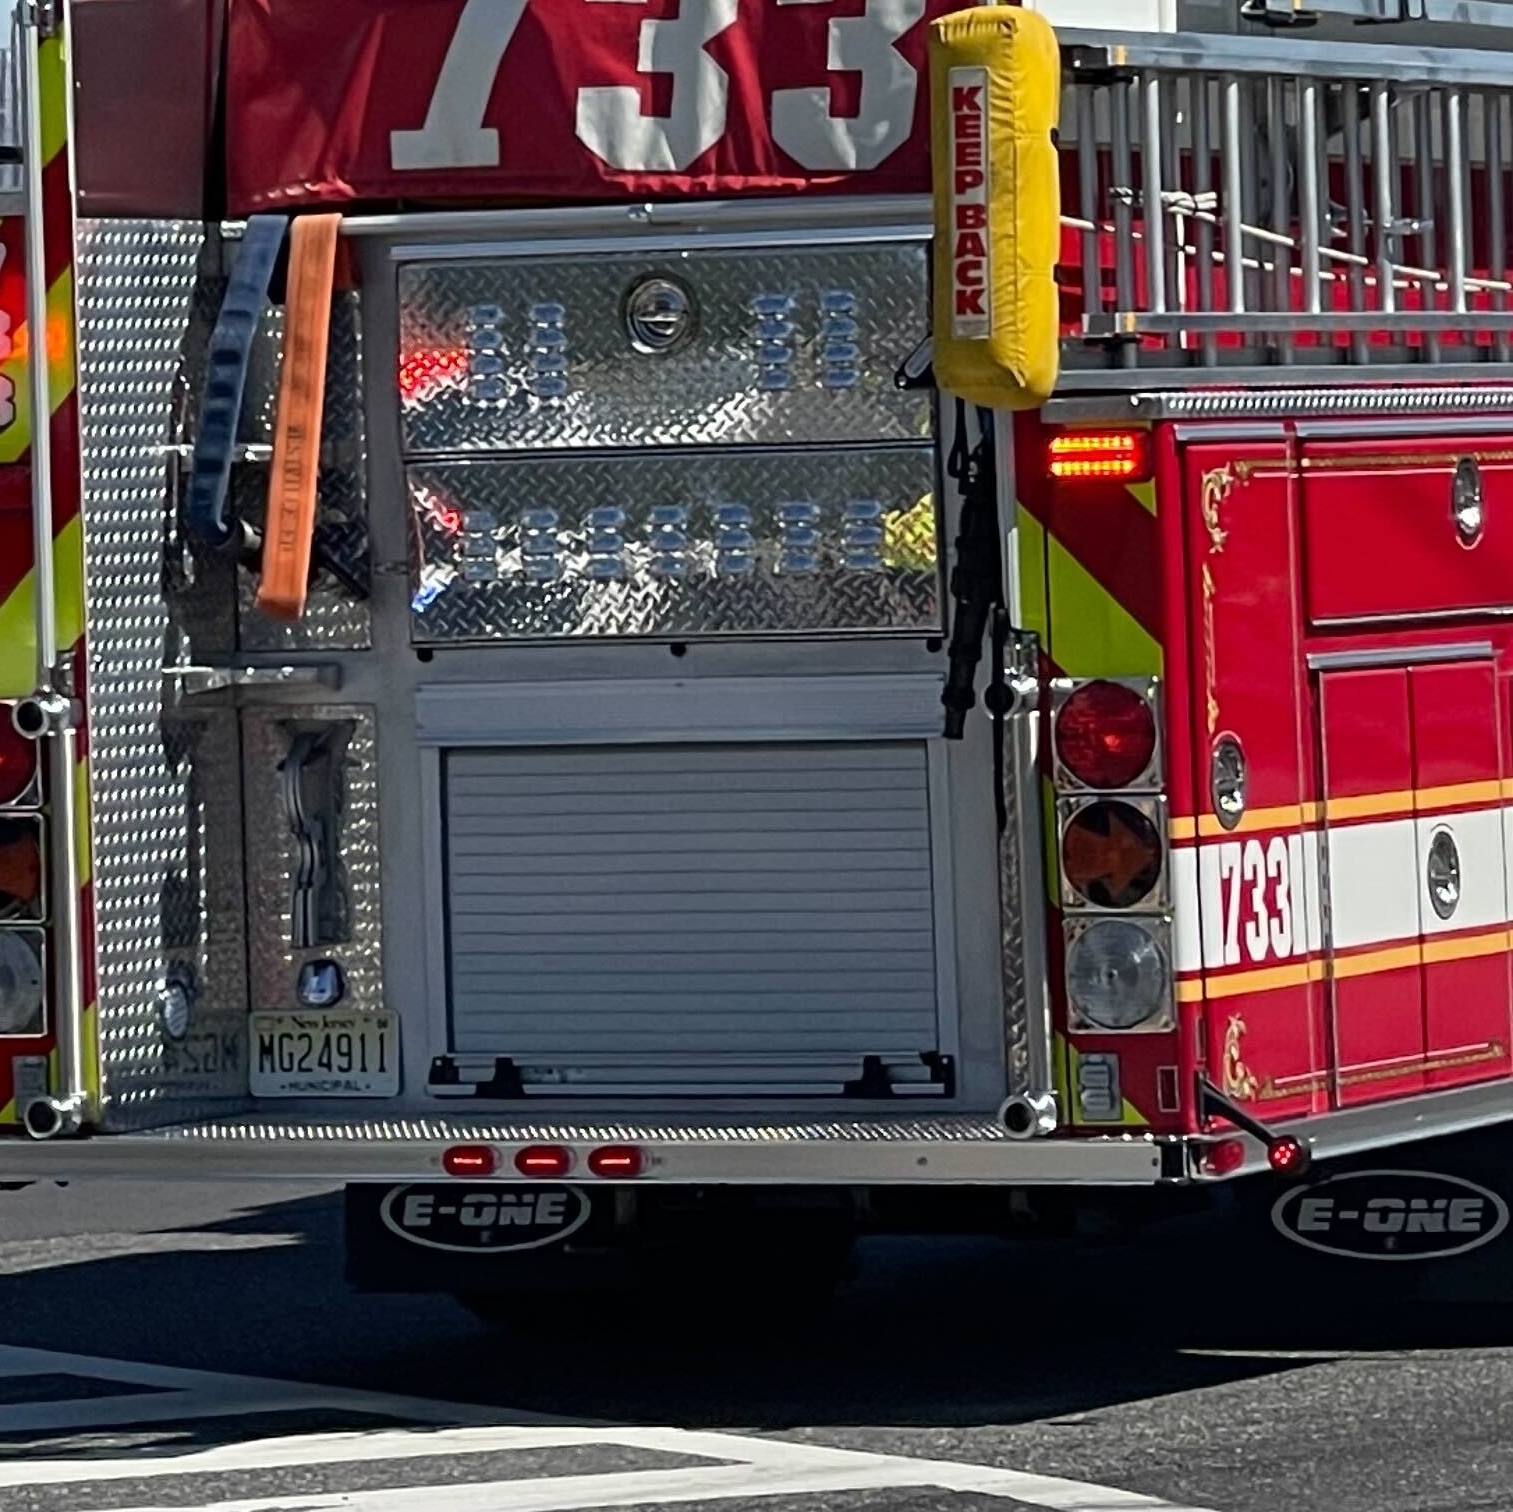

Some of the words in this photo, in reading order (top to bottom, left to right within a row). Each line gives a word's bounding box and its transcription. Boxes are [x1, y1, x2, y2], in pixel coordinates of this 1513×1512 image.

[952, 86, 984, 196] KEEP
[954, 202, 987, 316] BACK
[1220, 835, 1293, 966] 733
[258, 1032, 387, 1074] MG24911
[402, 1192, 567, 1226] E-ONE
[1296, 1198, 1484, 1233] E-ONE
